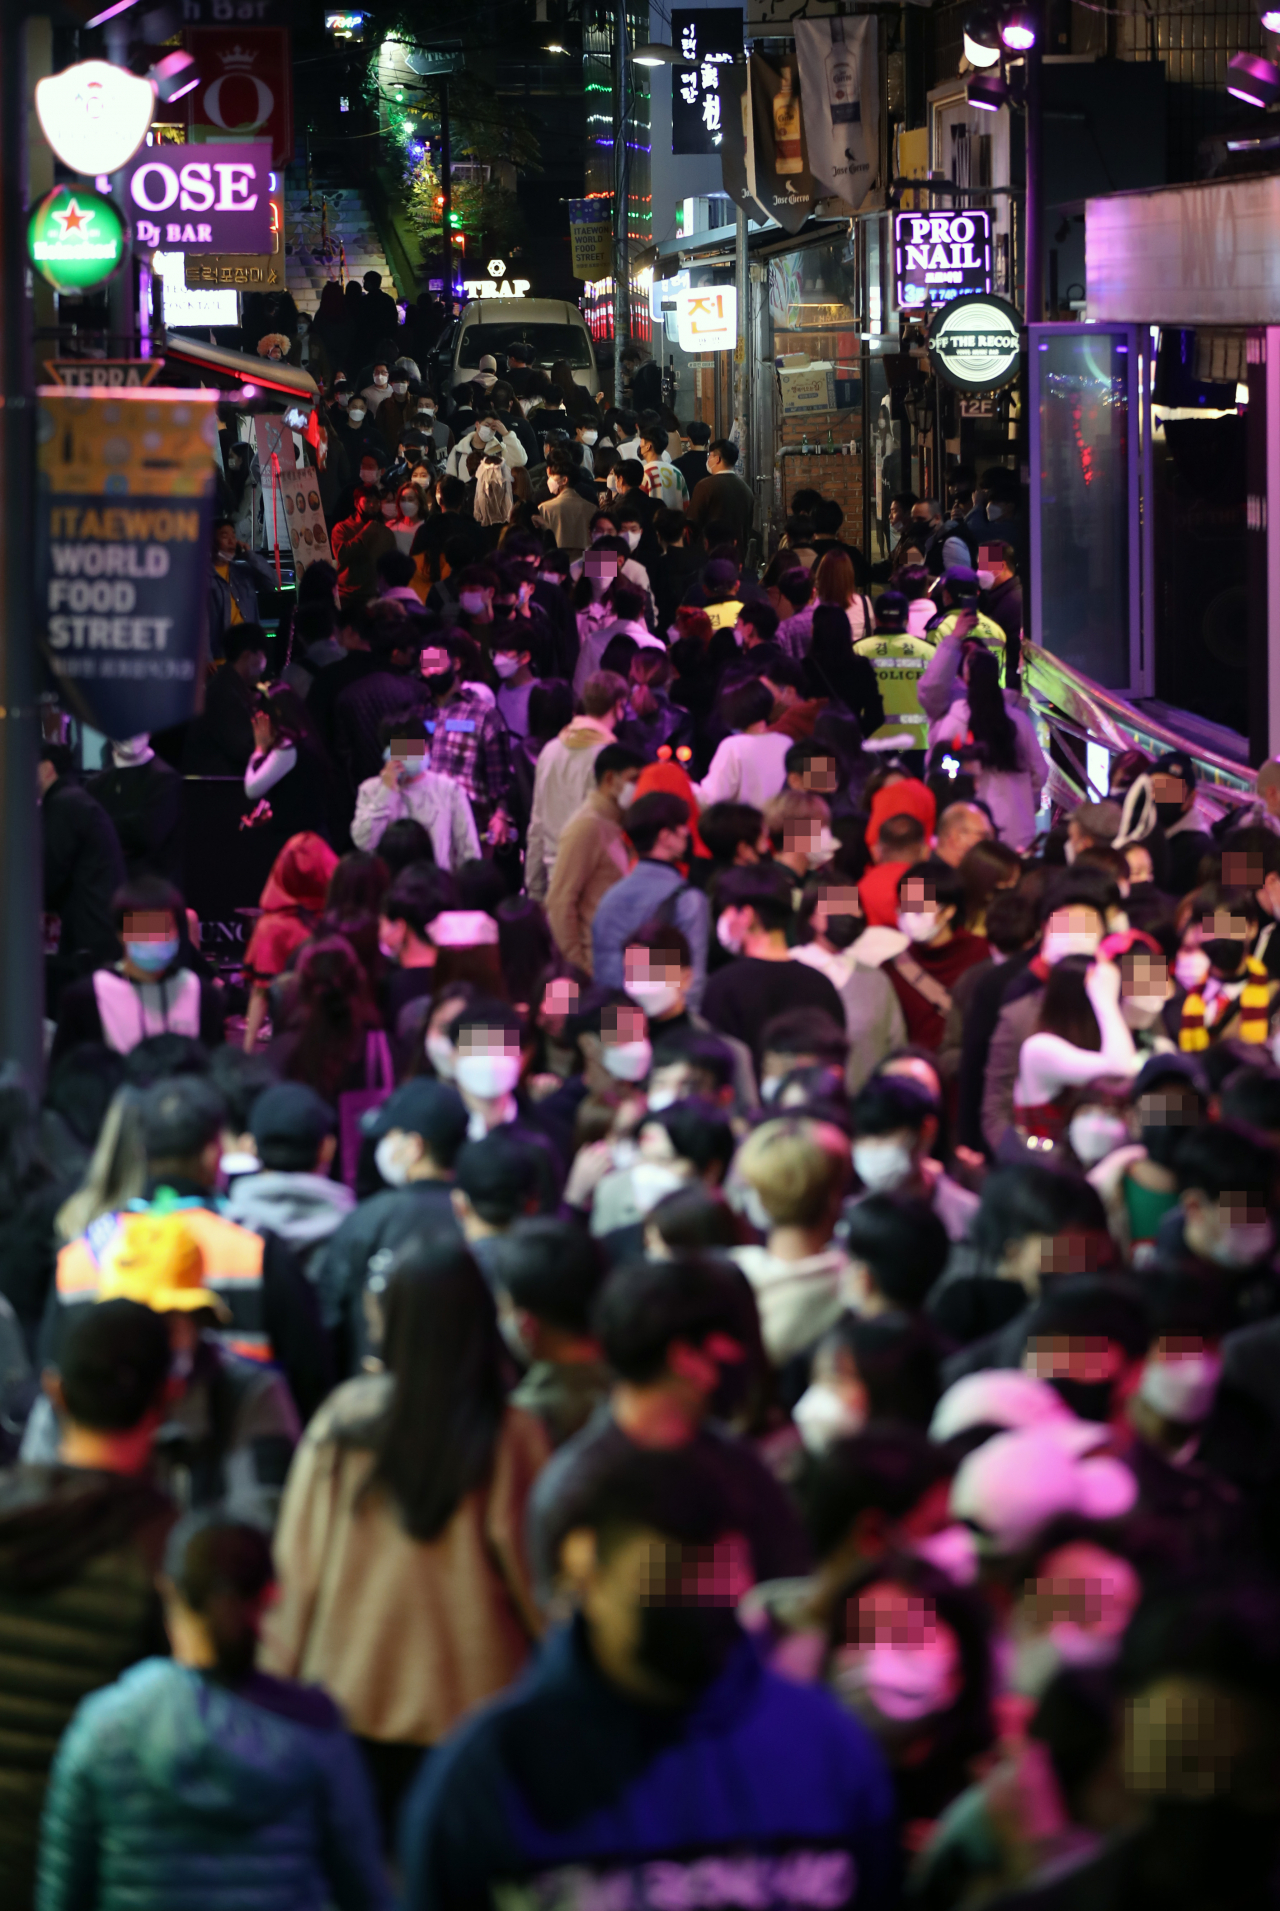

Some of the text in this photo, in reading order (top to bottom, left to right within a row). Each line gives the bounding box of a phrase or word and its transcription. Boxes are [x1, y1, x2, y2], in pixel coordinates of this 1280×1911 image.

[326, 15, 362, 28] TRAP
[130, 162, 258, 212] OSE
[772, 193, 810, 206] Jose Cuervo
[166, 223, 213, 242] BAR
[574, 226, 609, 235] ITAEWON
[575, 235, 603, 244] WORLD
[910, 217, 975, 244] PRO
[575, 244, 596, 252] FOOD
[576, 252, 604, 261] STREET
[904, 243, 982, 270] NAIL
[463, 279, 531, 299] TRAP
[904, 283, 926, 303] 3F
[687, 294, 728, 335] 전
[928, 337, 949, 350] OFF
[949, 334, 976, 348] THE
[968, 400, 993, 414] 2F
[50, 506, 200, 542] ITAEWON
[51, 543, 171, 578] WORLD
[48, 578, 137, 613] FOOD
[48, 615, 174, 650] STREET
[875, 670, 923, 681] OLICE
